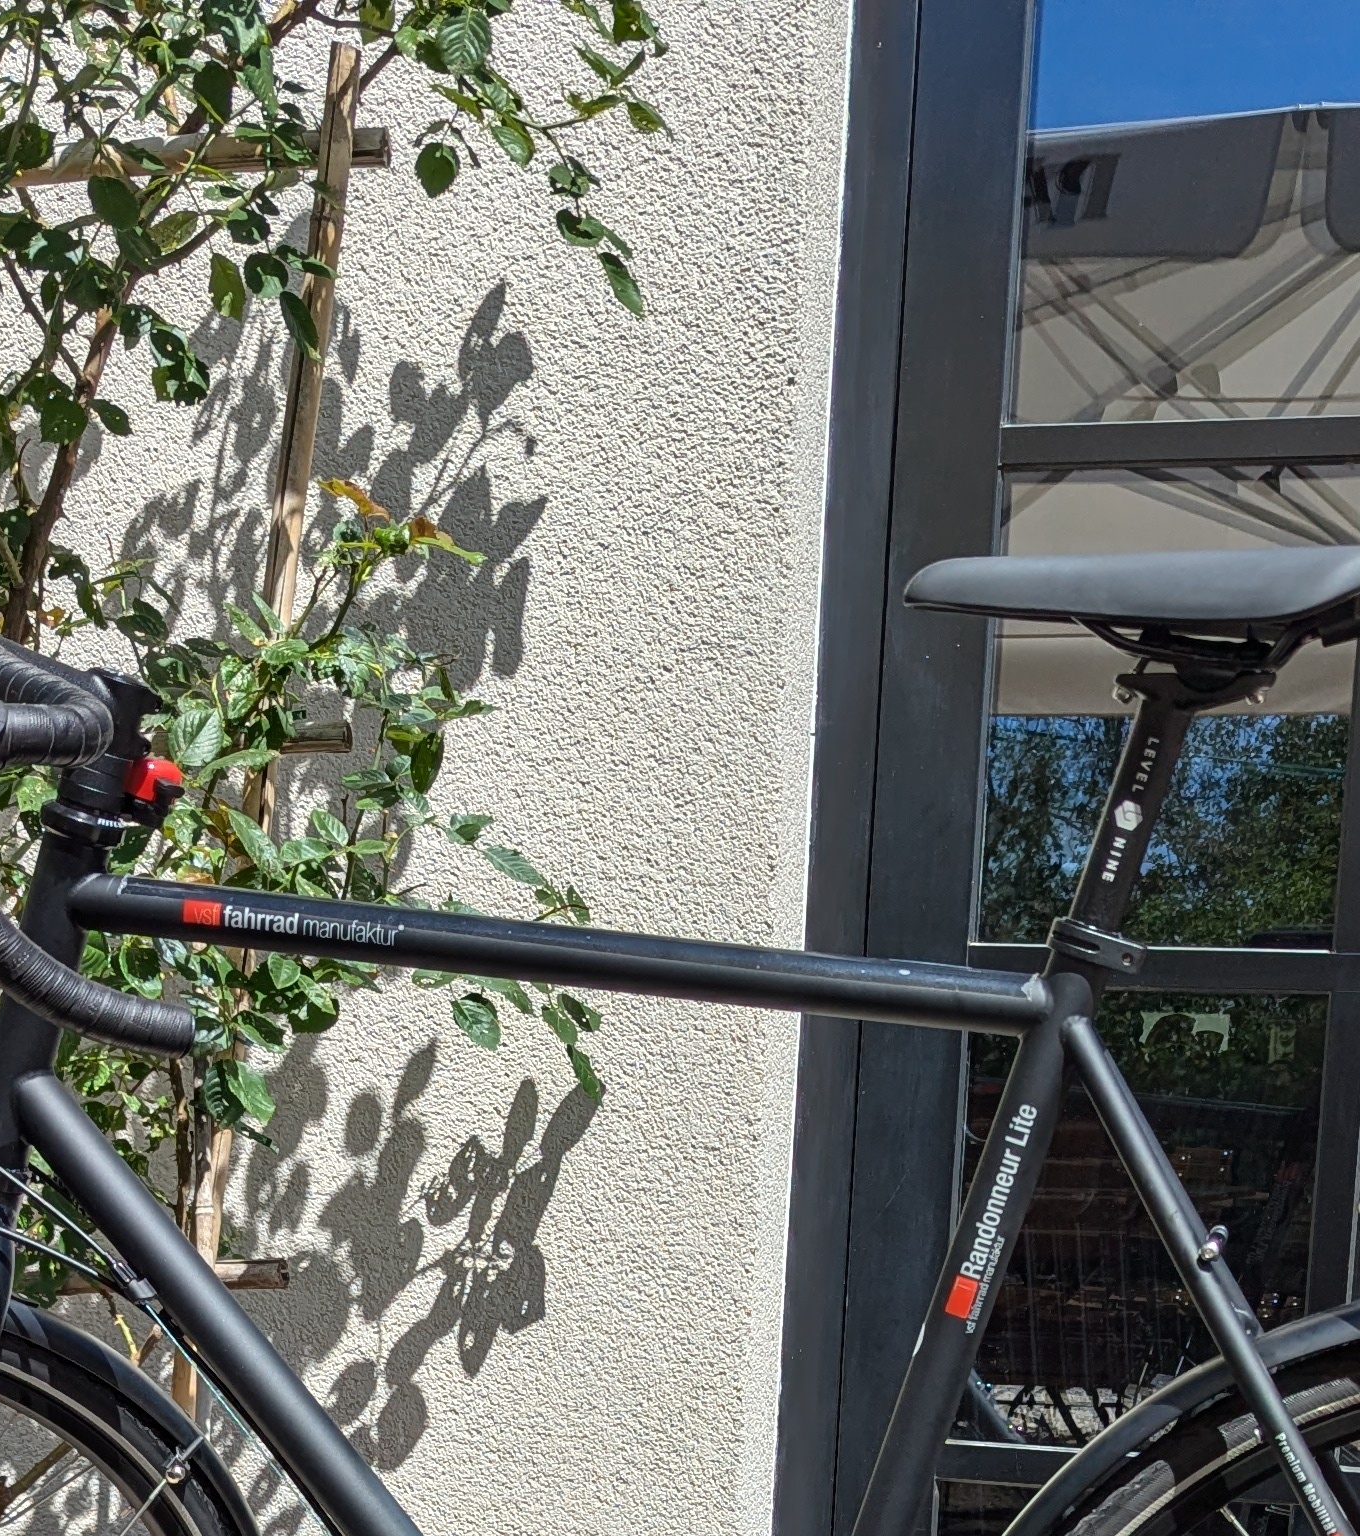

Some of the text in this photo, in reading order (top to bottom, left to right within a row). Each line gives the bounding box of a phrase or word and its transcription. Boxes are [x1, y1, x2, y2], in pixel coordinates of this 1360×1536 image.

[1101, 737, 1160, 883] LEVEL NINE
[959, 1103, 1038, 1280] Randonneur Lite
[1274, 1431, 1307, 1484] Premium
